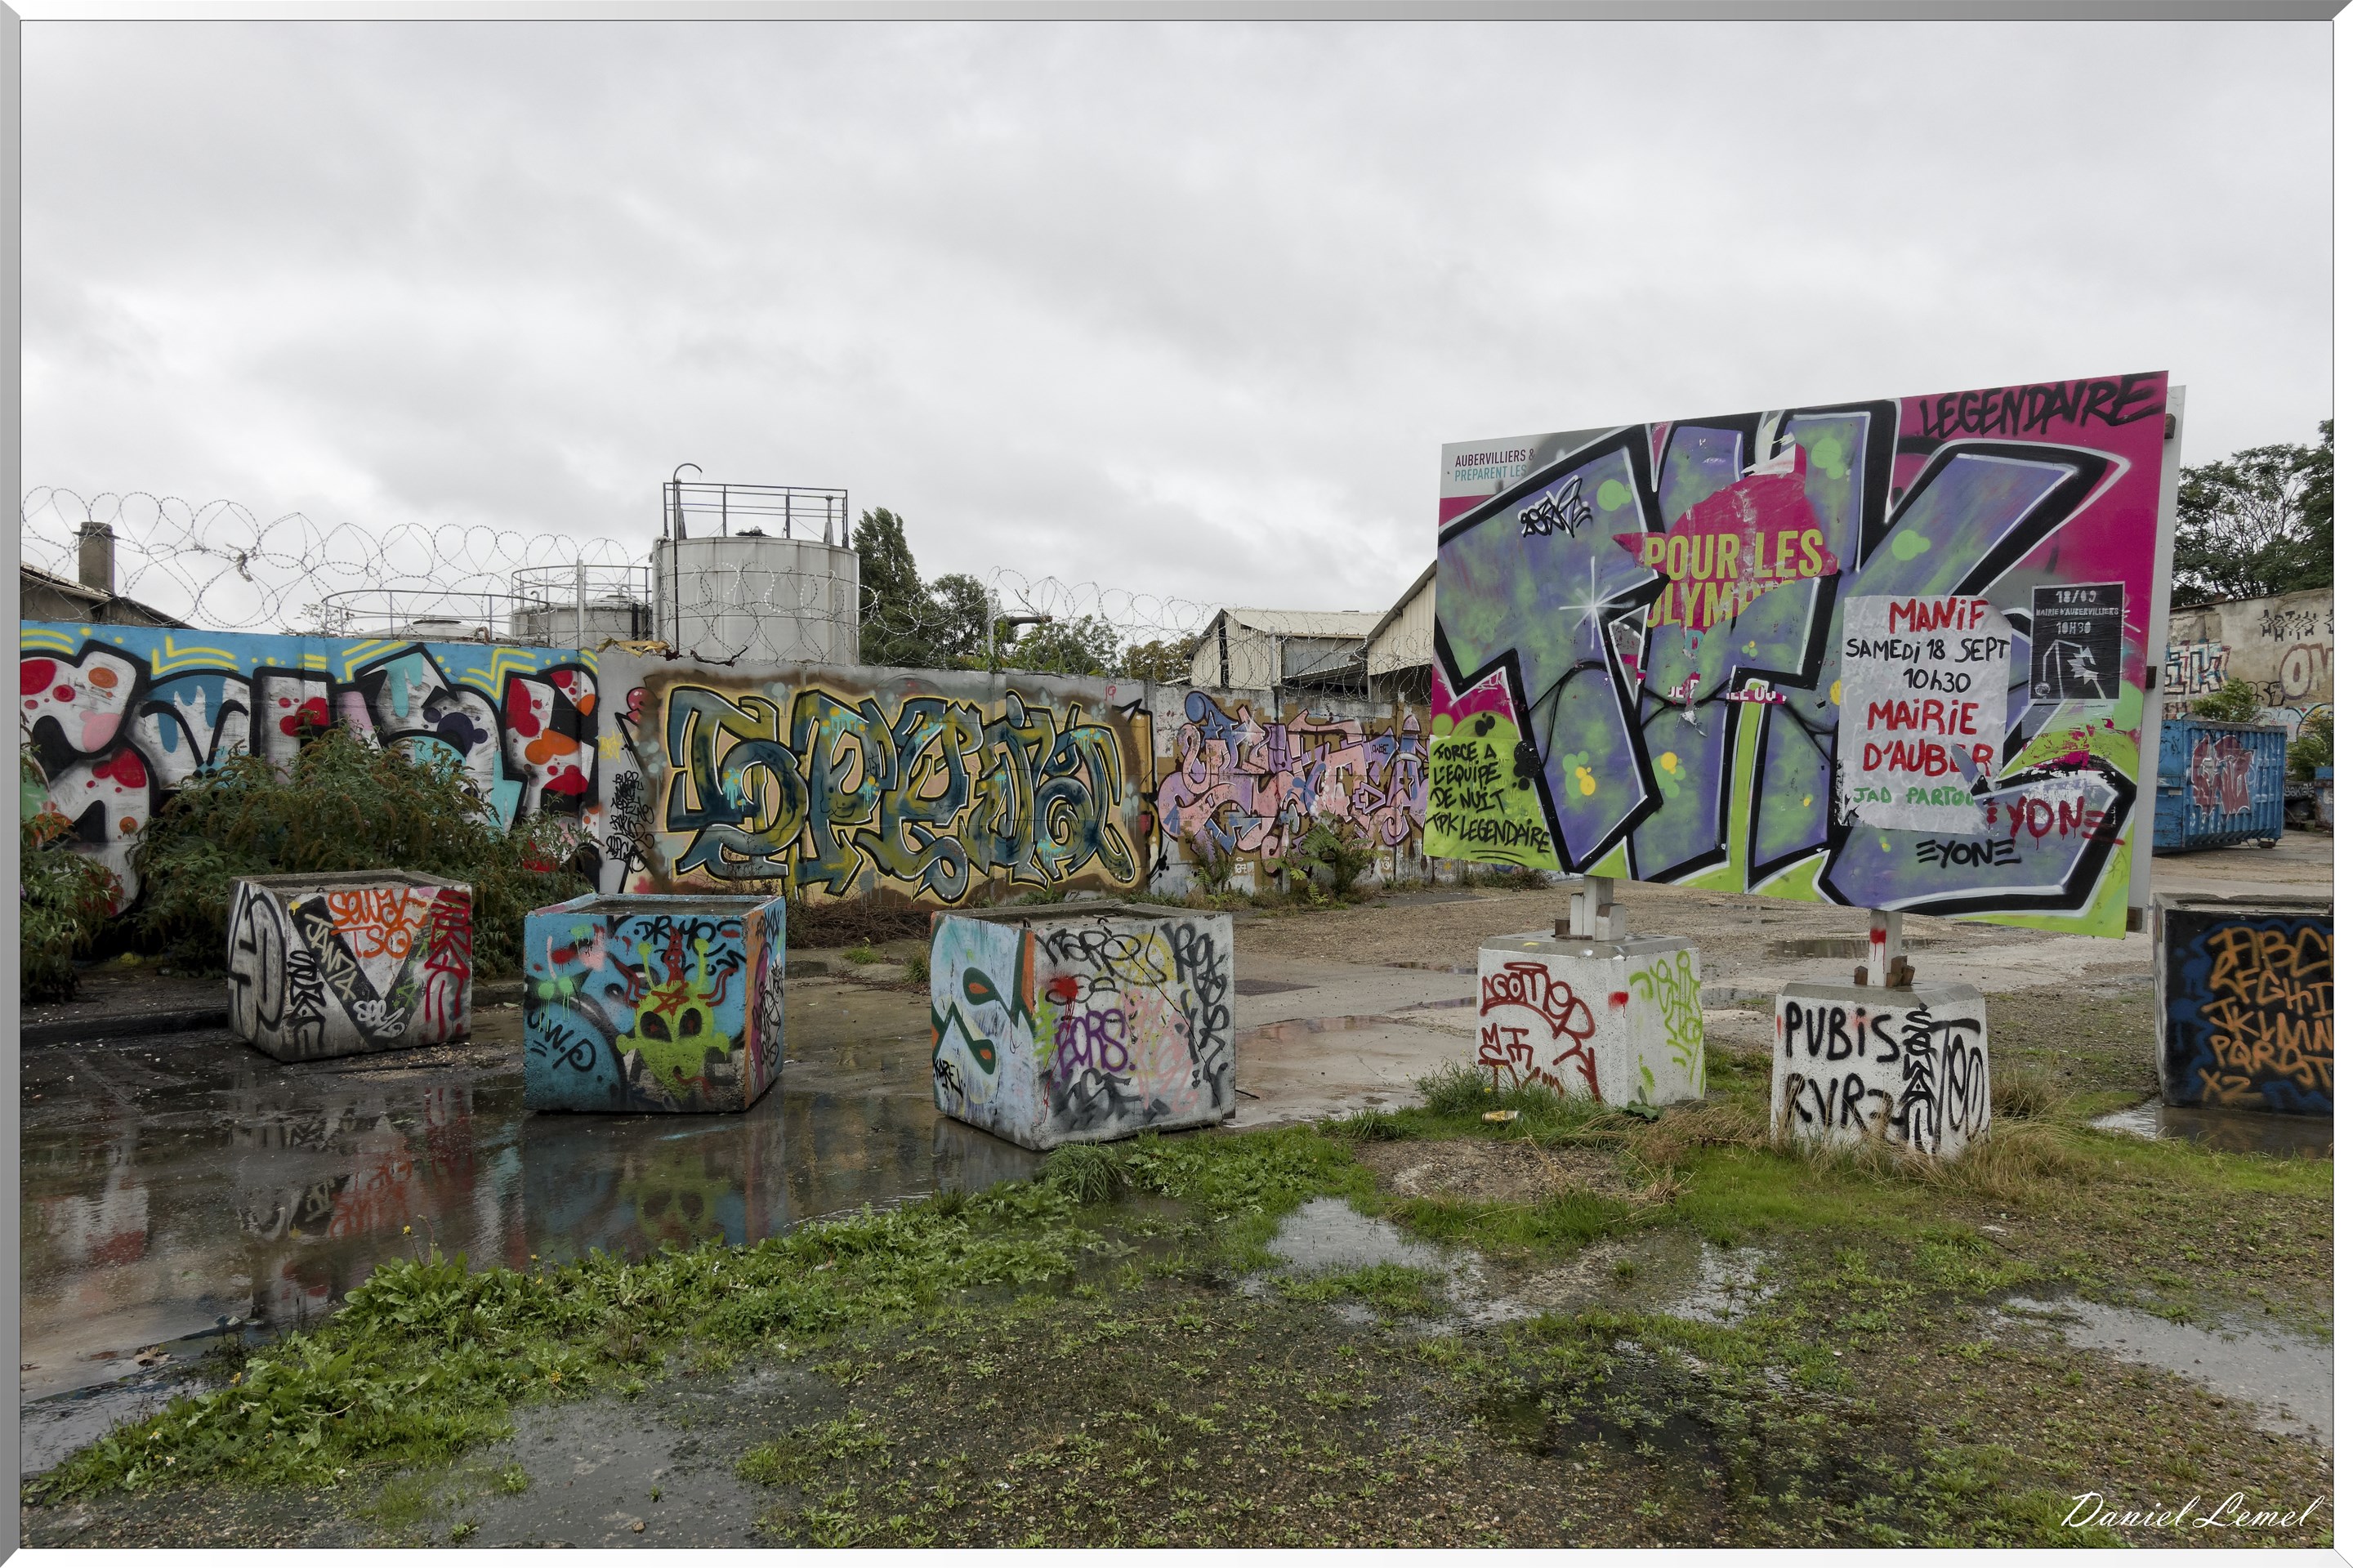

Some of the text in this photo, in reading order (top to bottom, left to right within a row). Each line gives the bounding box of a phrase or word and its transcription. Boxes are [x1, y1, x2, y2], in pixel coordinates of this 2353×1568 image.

[1919, 373, 2167, 439] LEGENDAIRE
[1455, 449, 1526, 467] AUBERVILLIERS
[1510, 464, 1527, 478] LES
[1645, 529, 1824, 581] POUR LES
[2056, 621, 2092, 635] 10H30
[1926, 638, 1945, 661] 18
[1954, 638, 2011, 663] SEPT
[1903, 668, 1971, 694] 10h30
[1434, 740, 1497, 761] FORCE A
[1431, 787, 1457, 809] DE
[1853, 786, 1892, 804] JAD
[1427, 812, 1458, 836] TPK
[1916, 838, 2022, 868] EYONE
